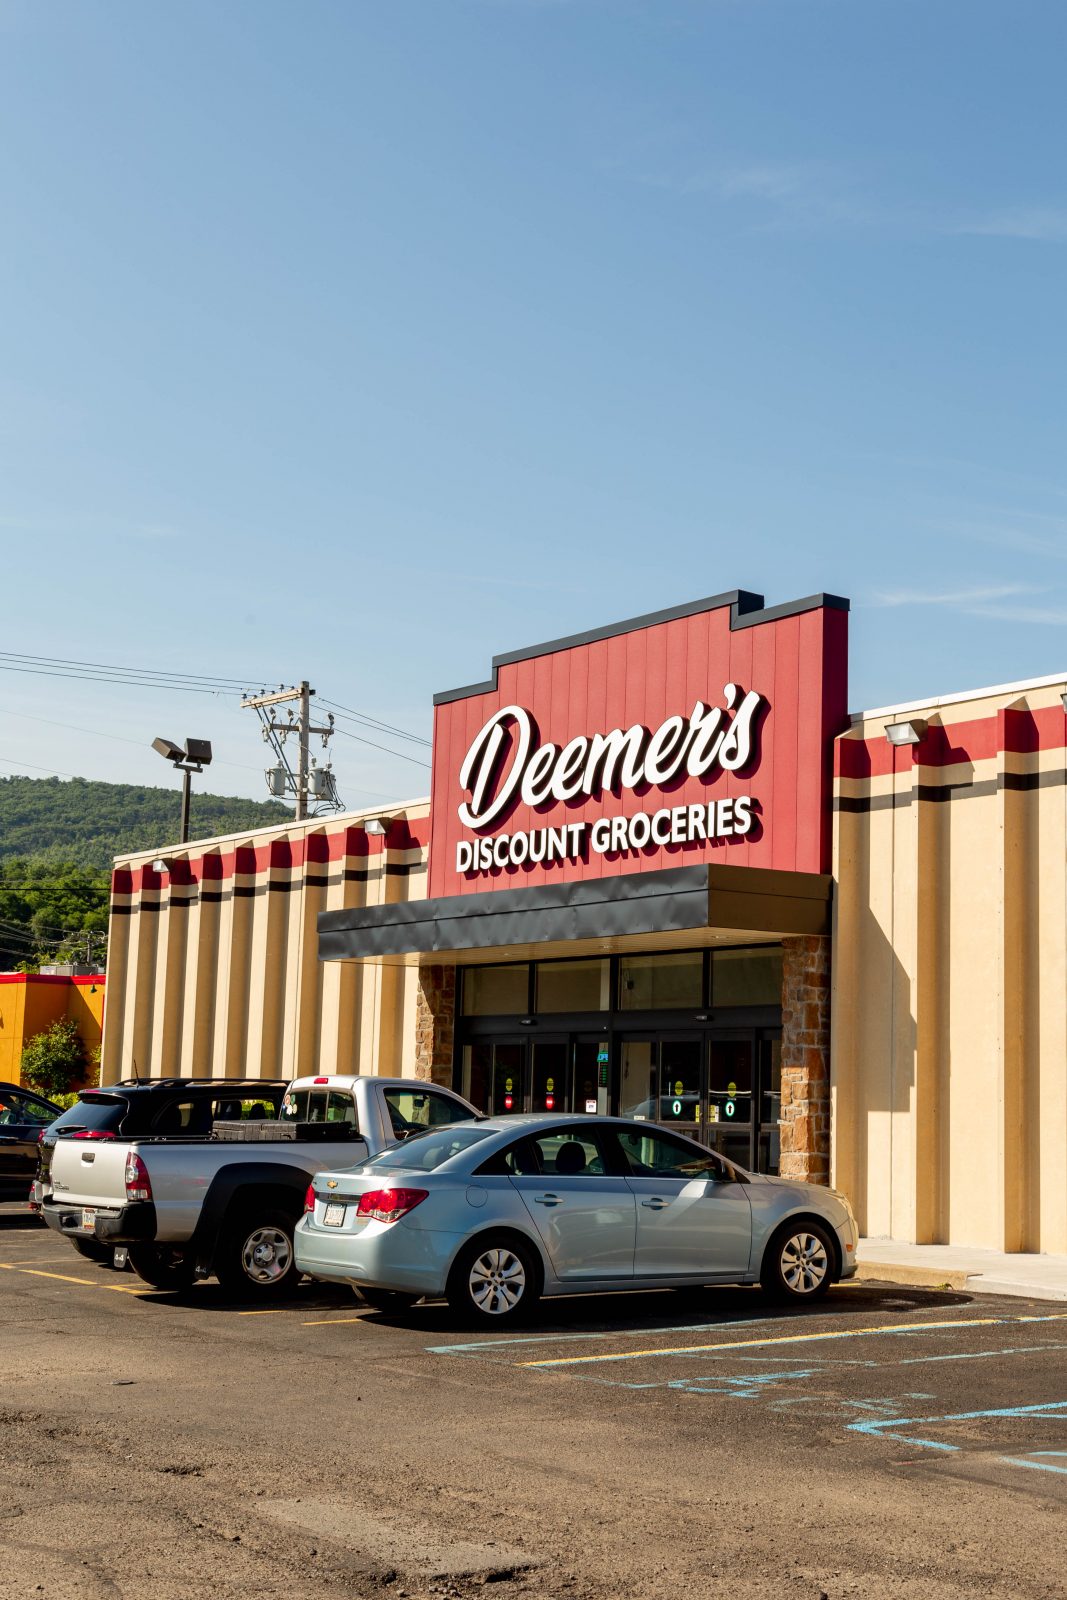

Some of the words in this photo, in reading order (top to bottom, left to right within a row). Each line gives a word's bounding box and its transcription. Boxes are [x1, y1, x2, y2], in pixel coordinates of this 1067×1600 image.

[458, 683, 760, 828] Deemer's
[456, 822, 585, 873] DISCOUNT
[591, 796, 751, 853] GROCERIES
